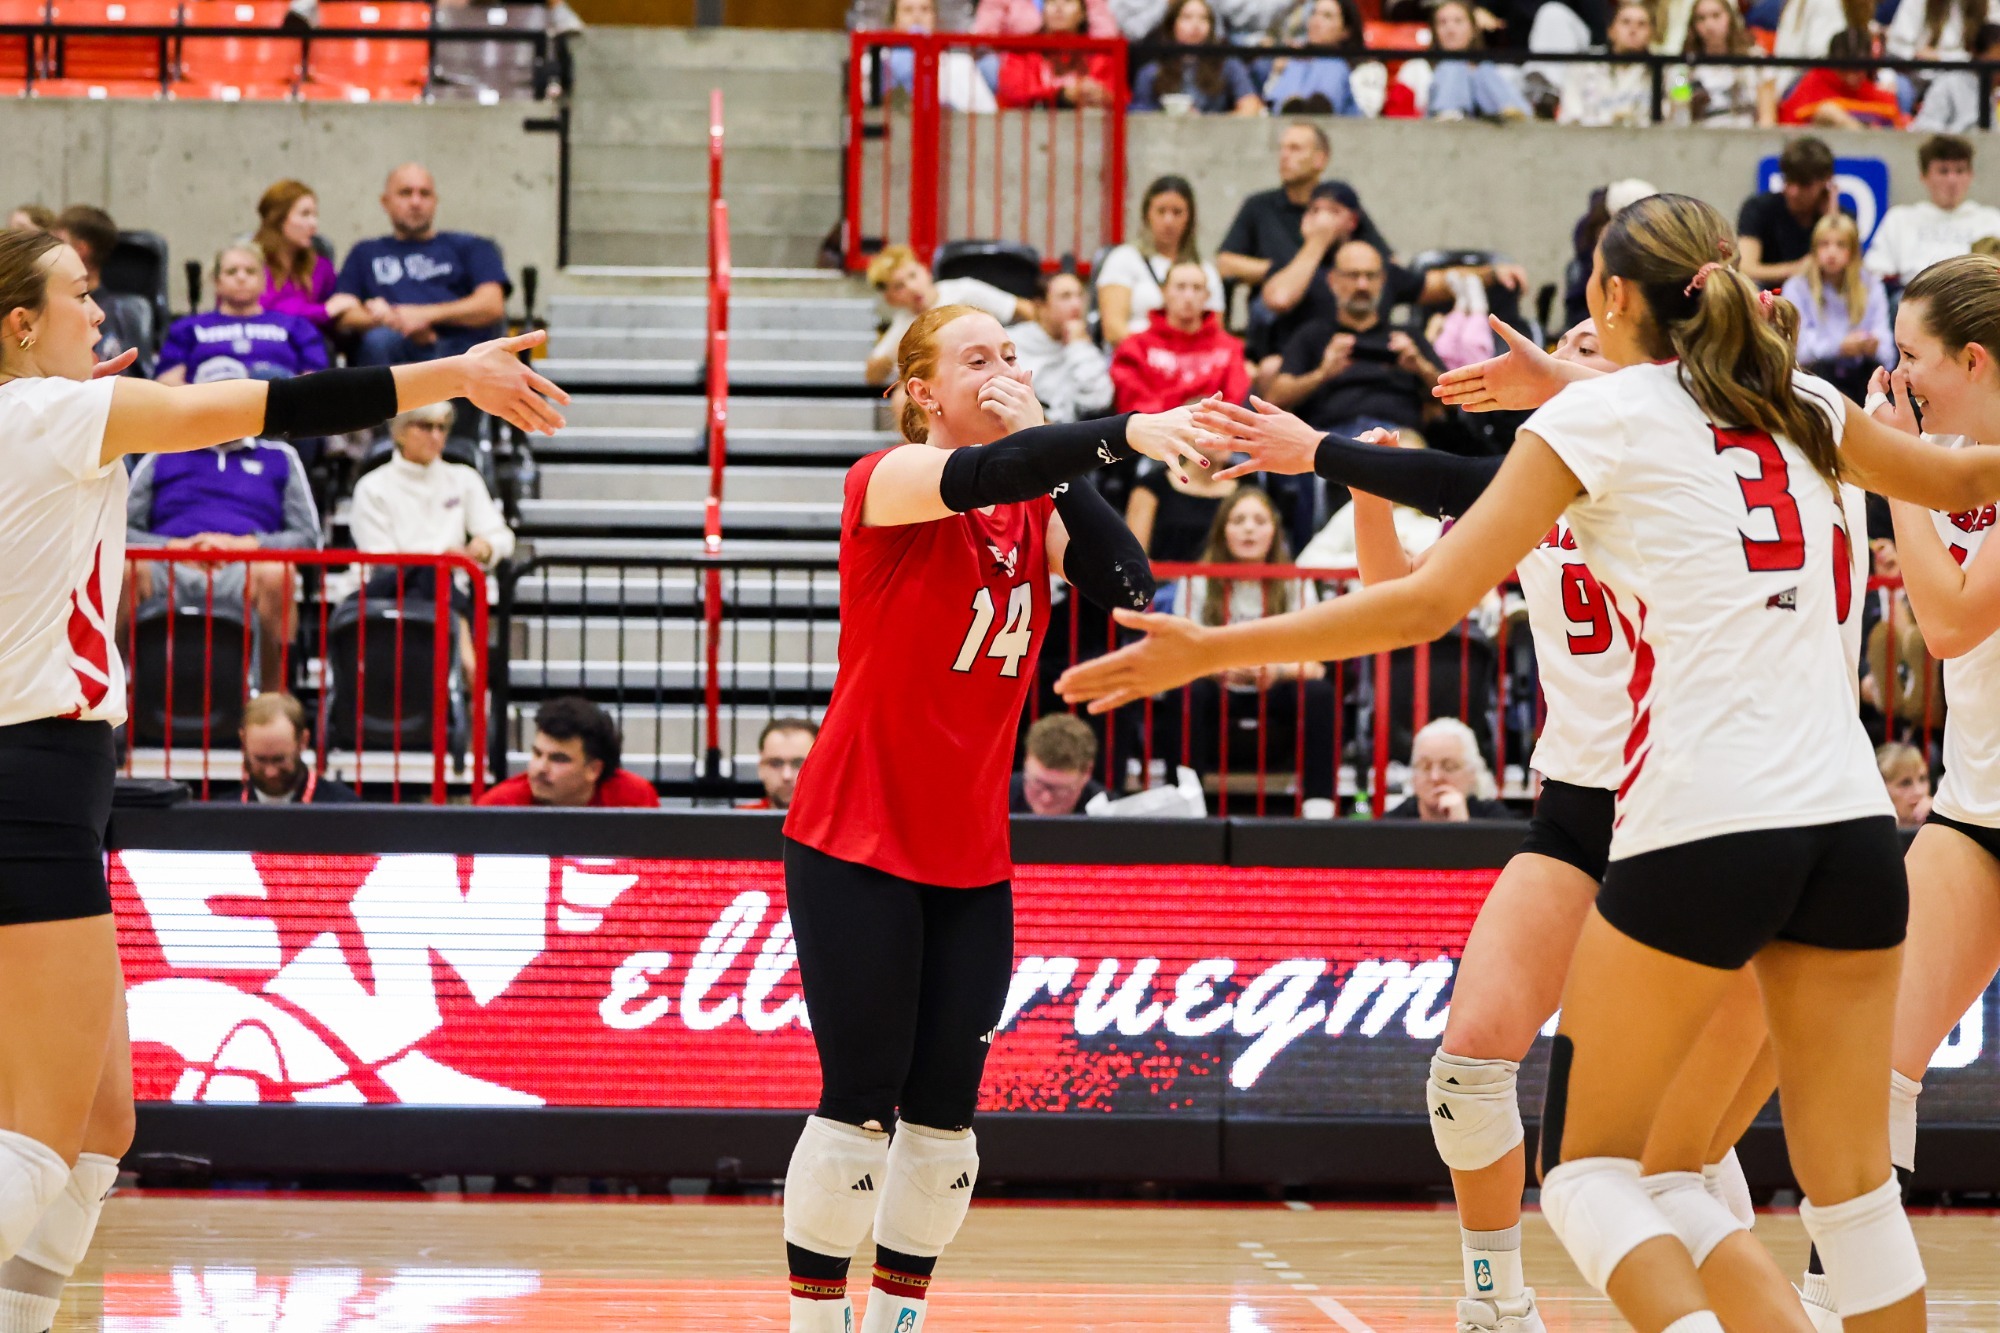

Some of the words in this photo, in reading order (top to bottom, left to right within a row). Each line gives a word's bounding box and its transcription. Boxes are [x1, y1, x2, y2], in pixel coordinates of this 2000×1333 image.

[1706, 423, 1805, 573] 3
[951, 581, 1033, 678] 14
[1561, 562, 1613, 656] 9
[598, 890, 812, 1031] ell
[997, 957, 1562, 1089] ruegm
[803, 1284, 847, 1294] MENA
[889, 1273, 931, 1286] MENA
